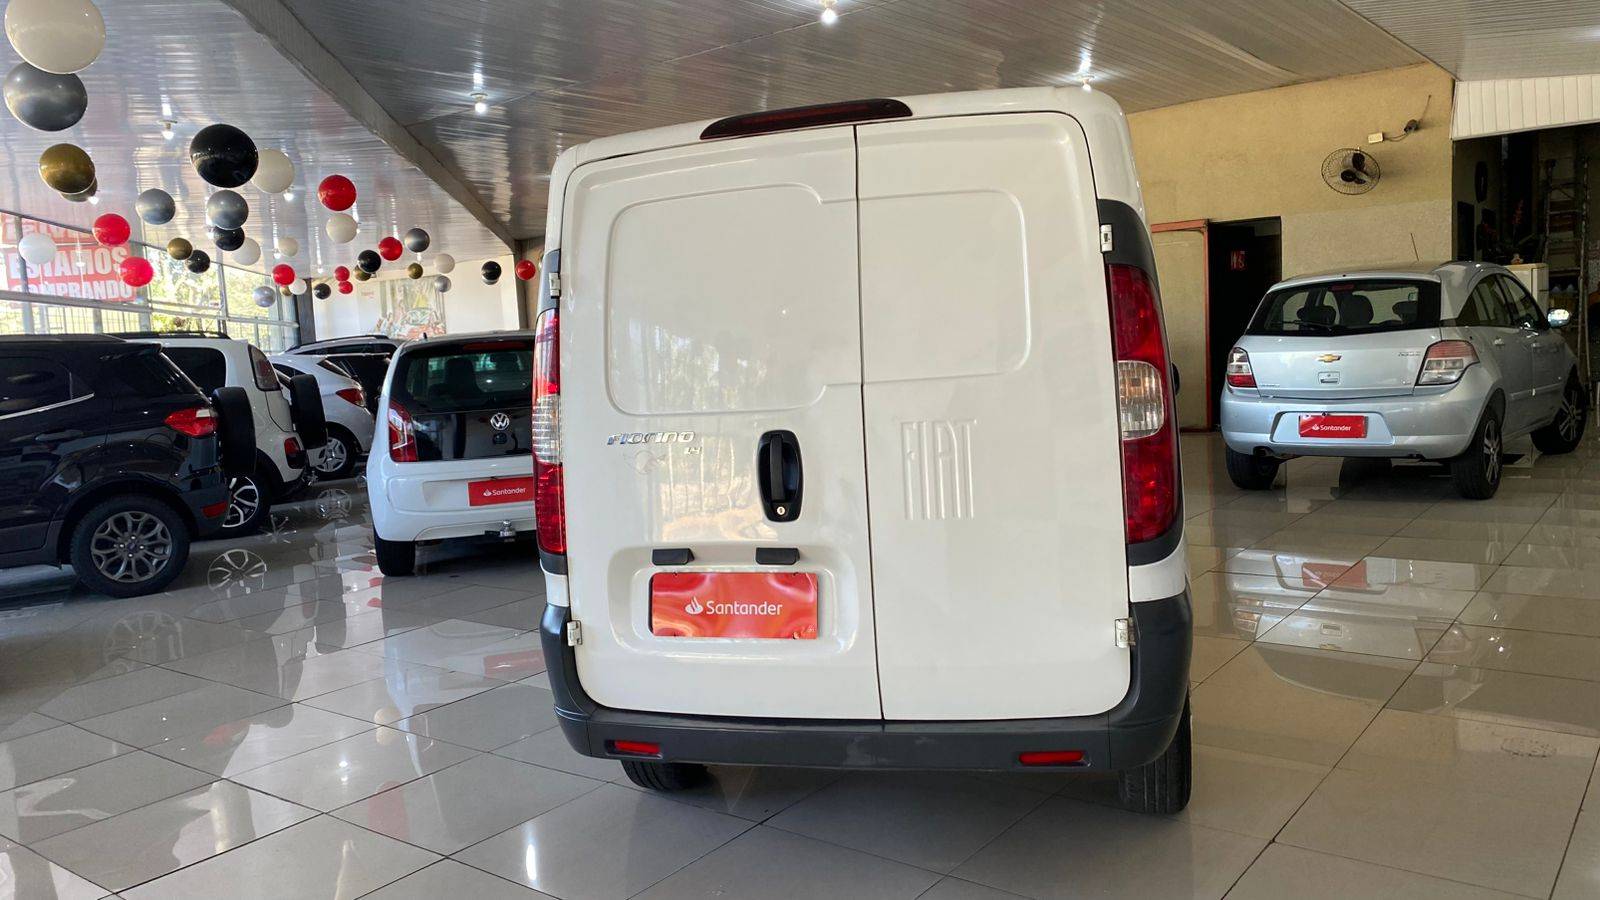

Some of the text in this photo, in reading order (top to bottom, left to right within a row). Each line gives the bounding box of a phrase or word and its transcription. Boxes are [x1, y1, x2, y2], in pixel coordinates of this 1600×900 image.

[900, 419, 976, 520] FIAT
[492, 487, 526, 496] Santander
[706, 600, 783, 615] Santander
